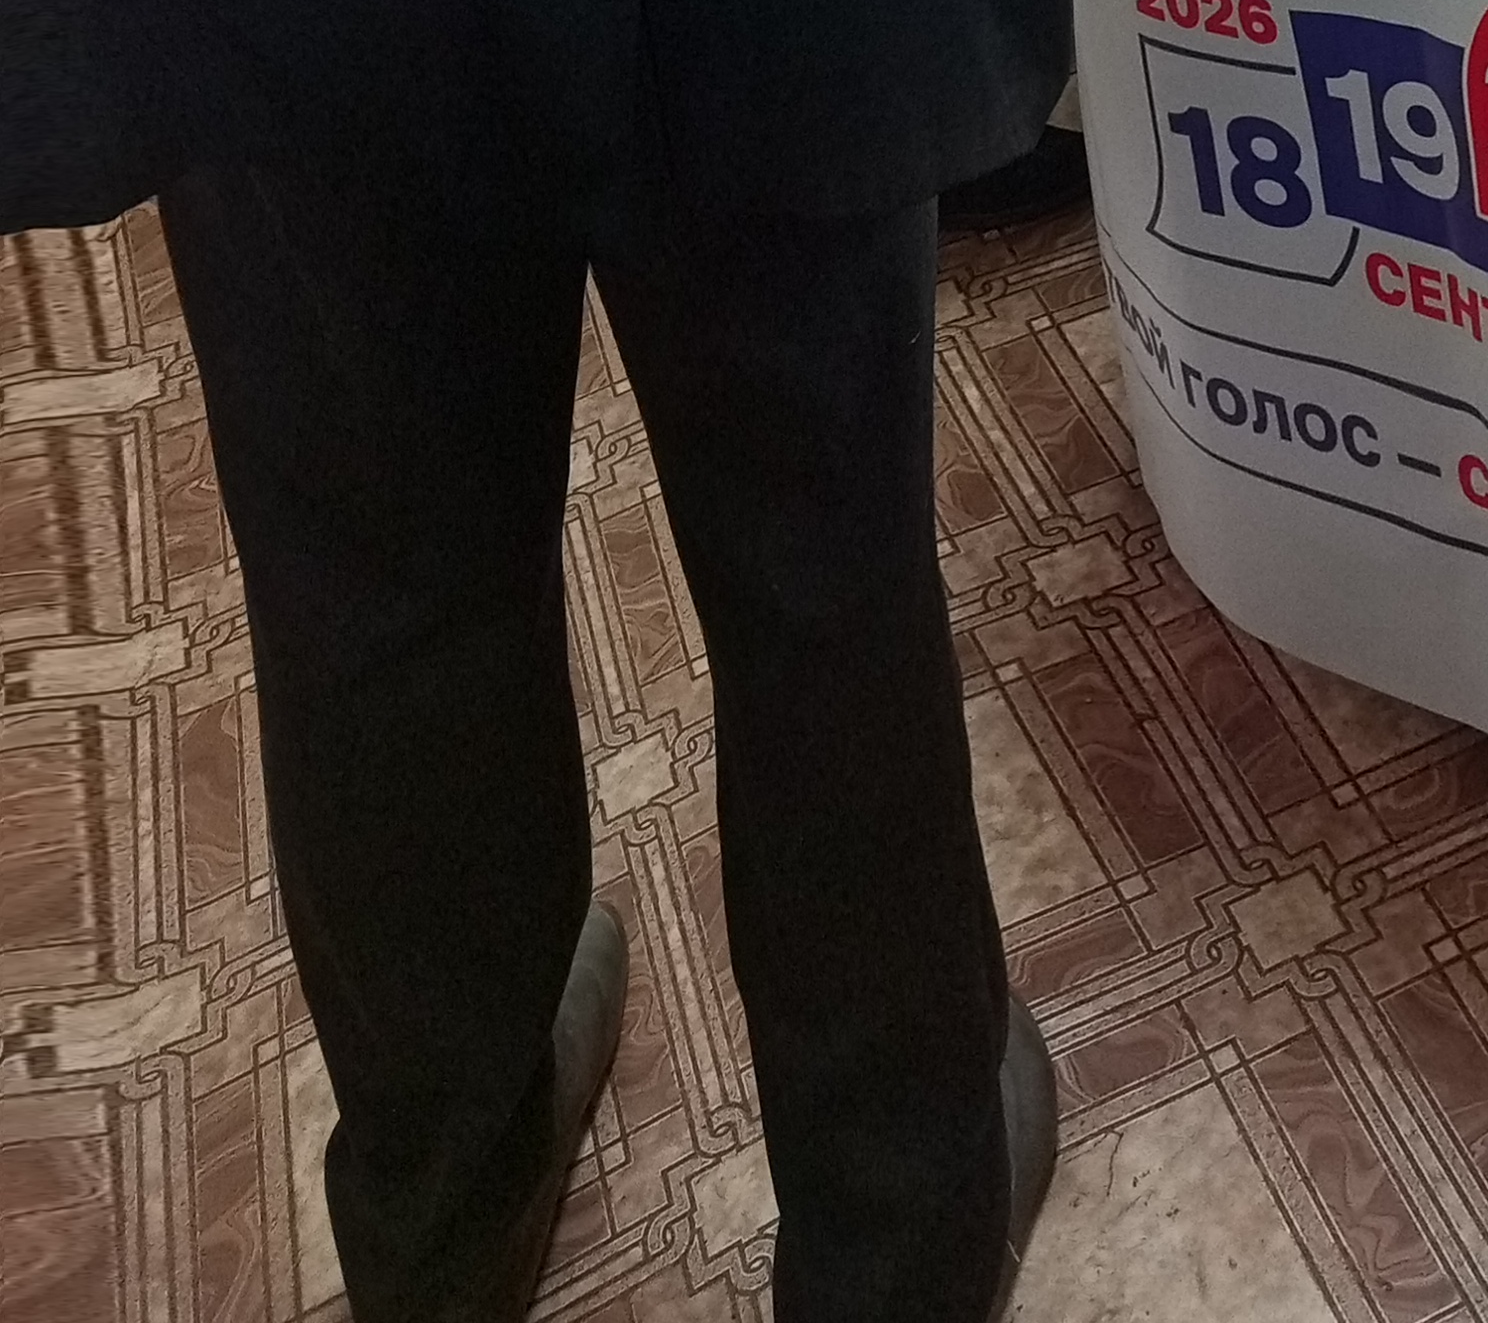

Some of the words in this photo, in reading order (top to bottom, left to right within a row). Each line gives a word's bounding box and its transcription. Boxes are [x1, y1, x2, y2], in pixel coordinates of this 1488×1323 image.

[1167, 106, 1312, 229] 18
[1324, 68, 1460, 201] 19
[1180, 358, 1382, 468] ГОЛОС
